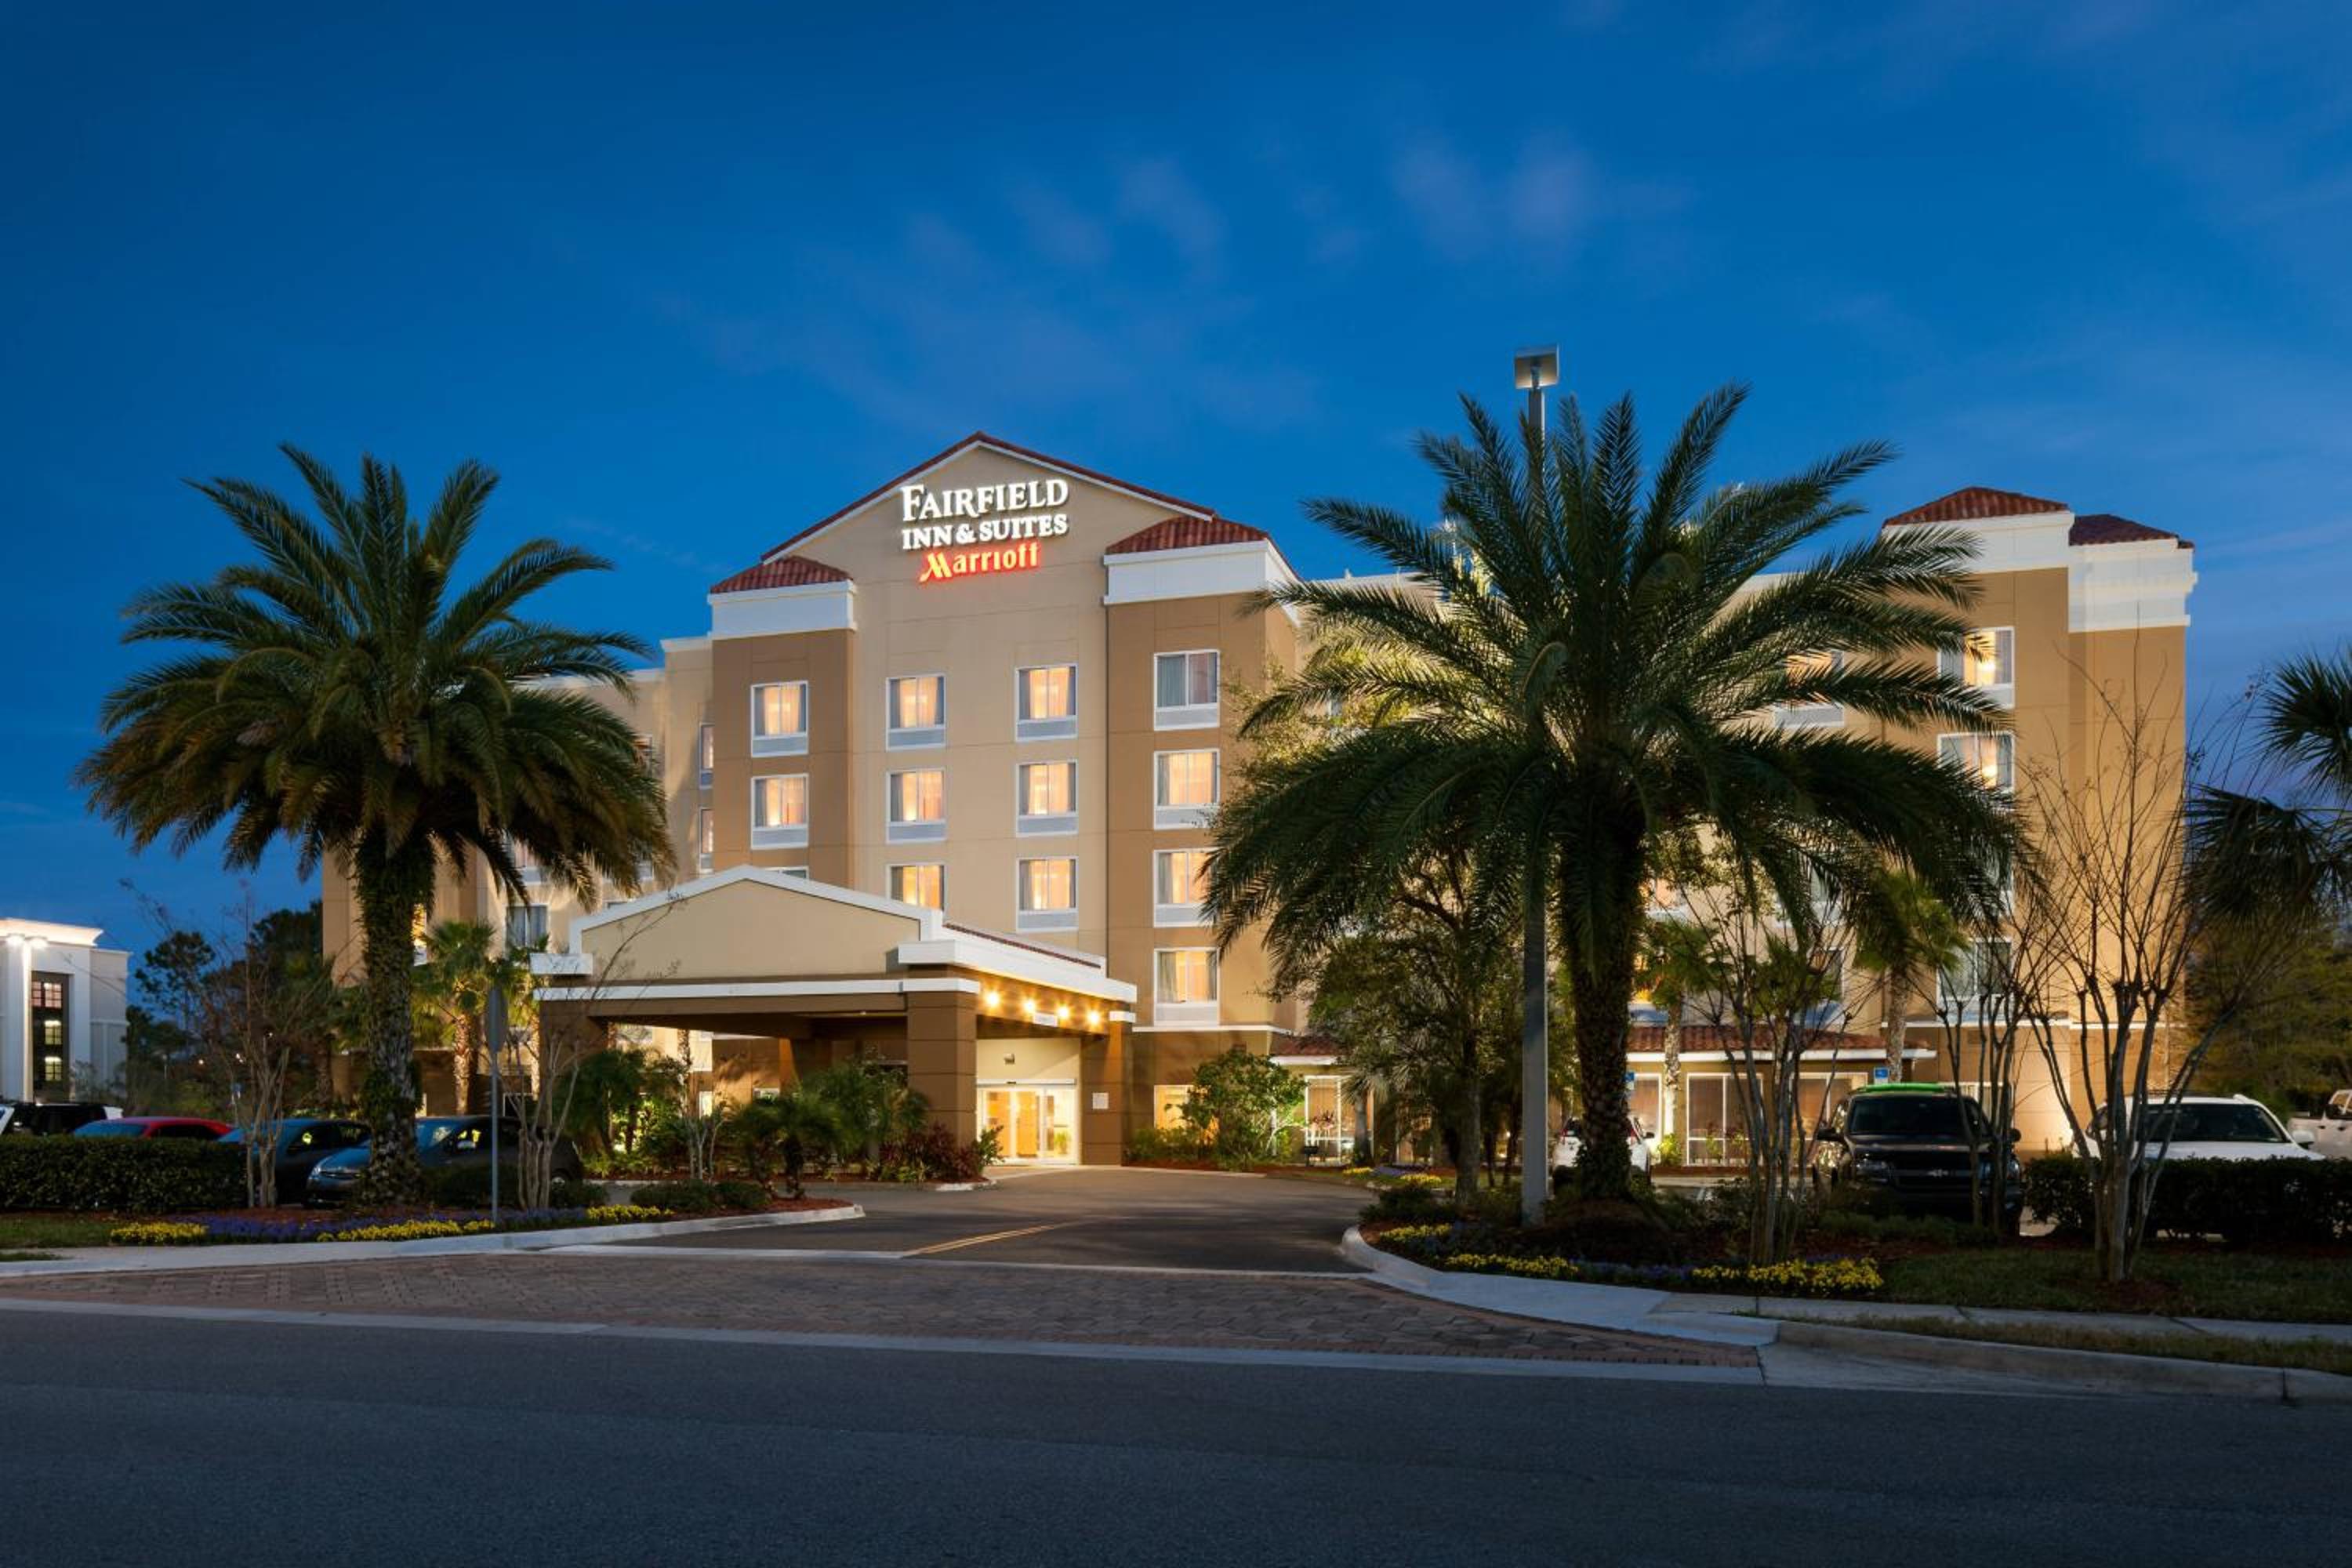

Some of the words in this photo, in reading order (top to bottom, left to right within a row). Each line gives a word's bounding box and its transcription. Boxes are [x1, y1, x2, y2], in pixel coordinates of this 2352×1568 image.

[901, 479, 1069, 521] FAIRFIELD
[902, 524, 953, 550] INN
[956, 523, 976, 543] &
[979, 514, 1069, 542] SUITES
[918, 541, 1039, 583] Marriott
